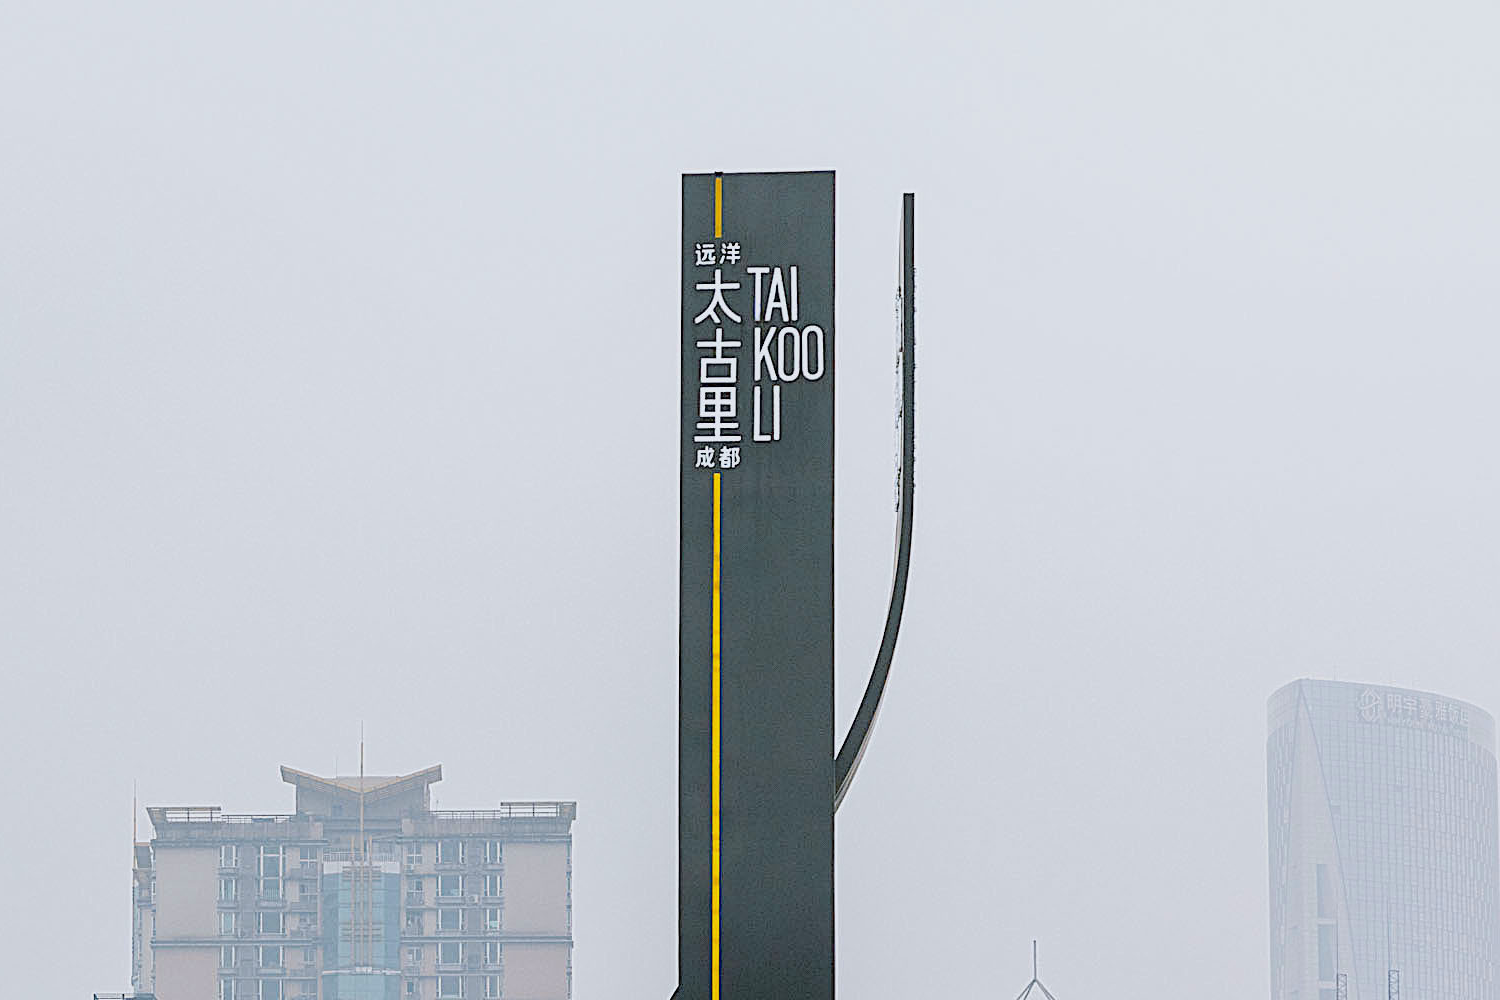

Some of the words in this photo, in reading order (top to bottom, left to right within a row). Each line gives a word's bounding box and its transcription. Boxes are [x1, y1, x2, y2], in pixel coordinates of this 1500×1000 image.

[694, 242, 741, 265] 远洋
[747, 266, 798, 322] TAI
[694, 269, 742, 442] 太古里
[753, 325, 824, 382] KOO
[753, 384, 780, 441] LI
[695, 446, 741, 468] 成都
